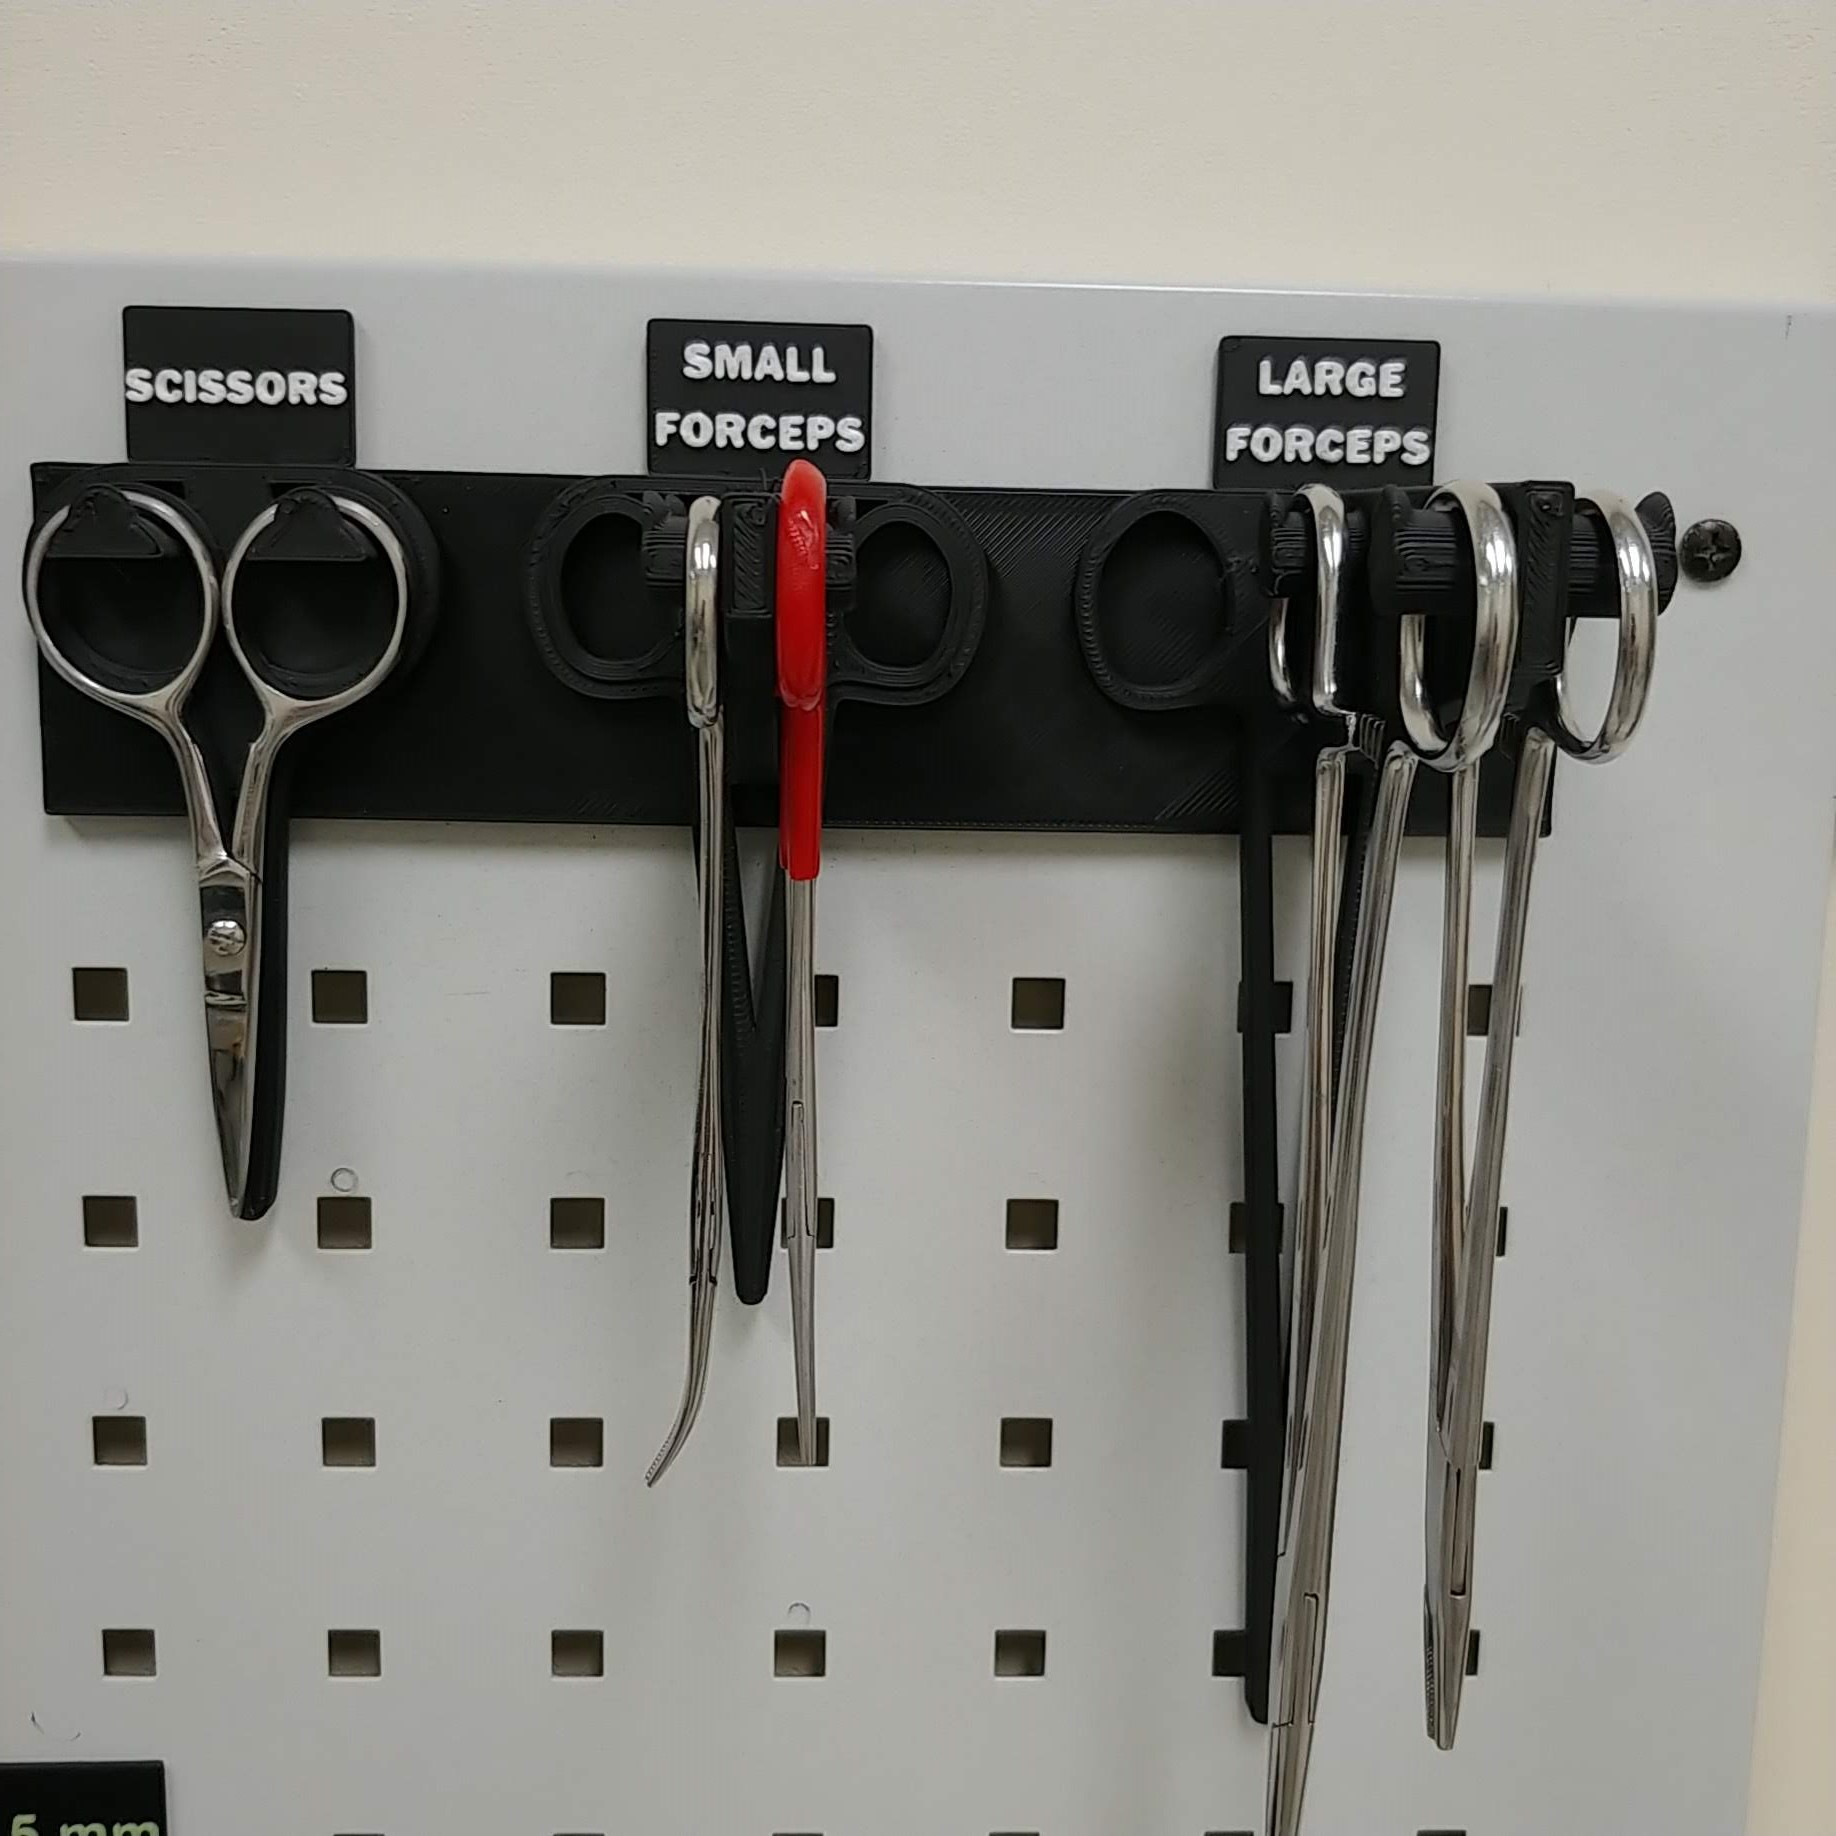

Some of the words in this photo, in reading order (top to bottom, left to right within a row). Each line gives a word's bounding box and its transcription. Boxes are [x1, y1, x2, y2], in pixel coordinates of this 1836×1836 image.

[682, 342, 836, 383] SMALL
[1258, 359, 1405, 397] LARGE
[125, 368, 348, 405] SCISSORS
[655, 411, 865, 452] FORCEPS
[1225, 426, 1431, 465] FORCEPS
